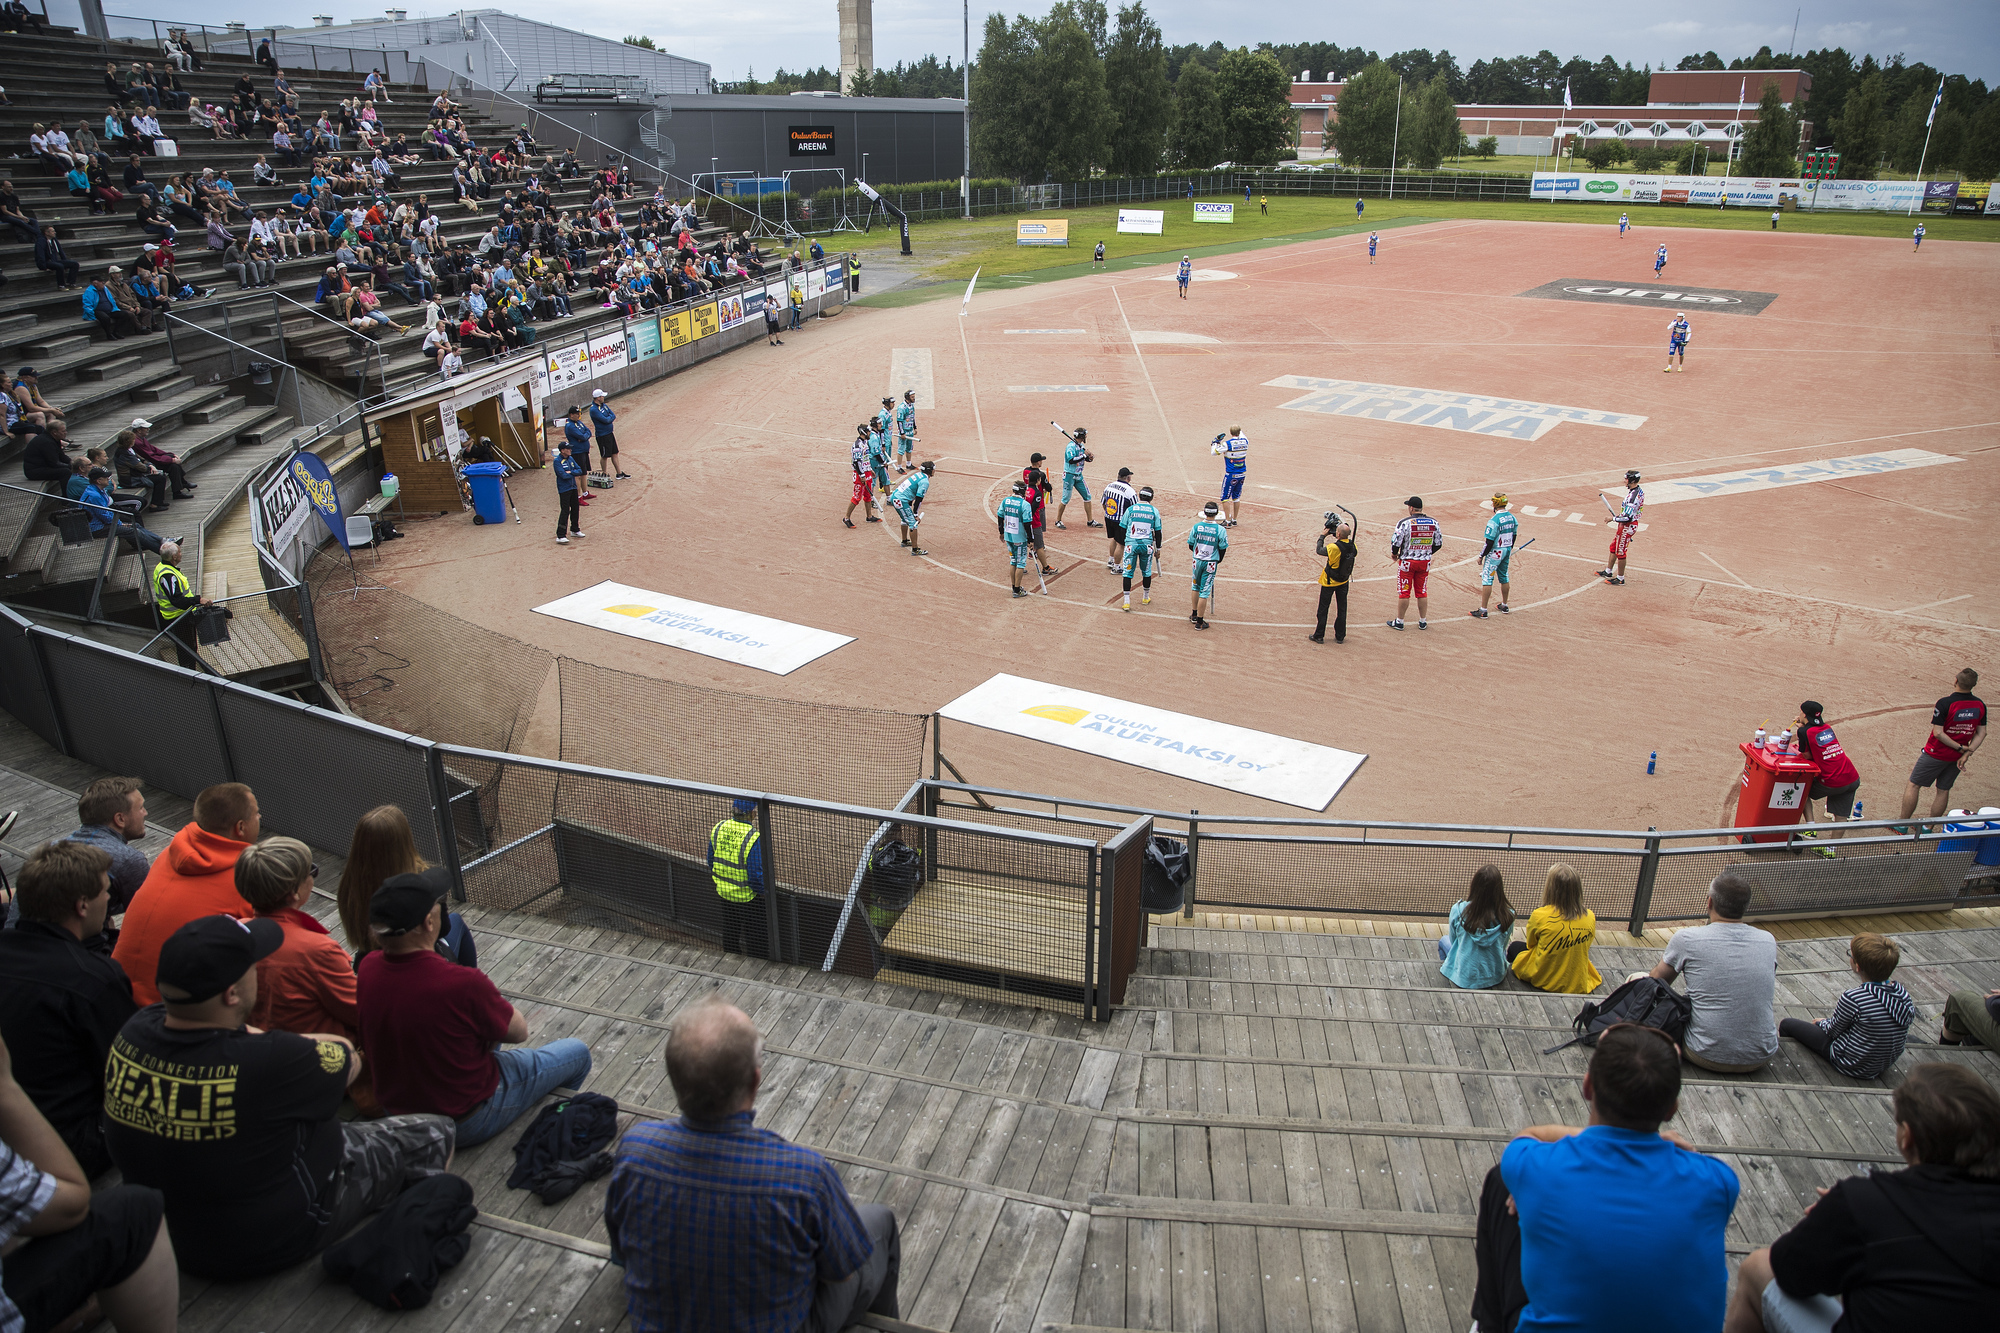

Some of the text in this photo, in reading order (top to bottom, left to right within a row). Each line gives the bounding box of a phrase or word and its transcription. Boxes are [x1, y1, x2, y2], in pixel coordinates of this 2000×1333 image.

[798, 142, 828, 151] AREENA
[1828, 156, 1839, 164] 02
[1588, 182, 1616, 190] Specsavers
[1848, 183, 1863, 191] VESI
[1293, 377, 1629, 425] WETTERI
[1287, 393, 1543, 439] ARINA
[658, 609, 702, 623] OULUN
[641, 615, 769, 649] ALUETAKSI OY
[1094, 713, 1157, 732] OULUN
[1081, 721, 1268, 772] ALUETAKSI OY
[141, 1053, 239, 1079] CONNECTION
